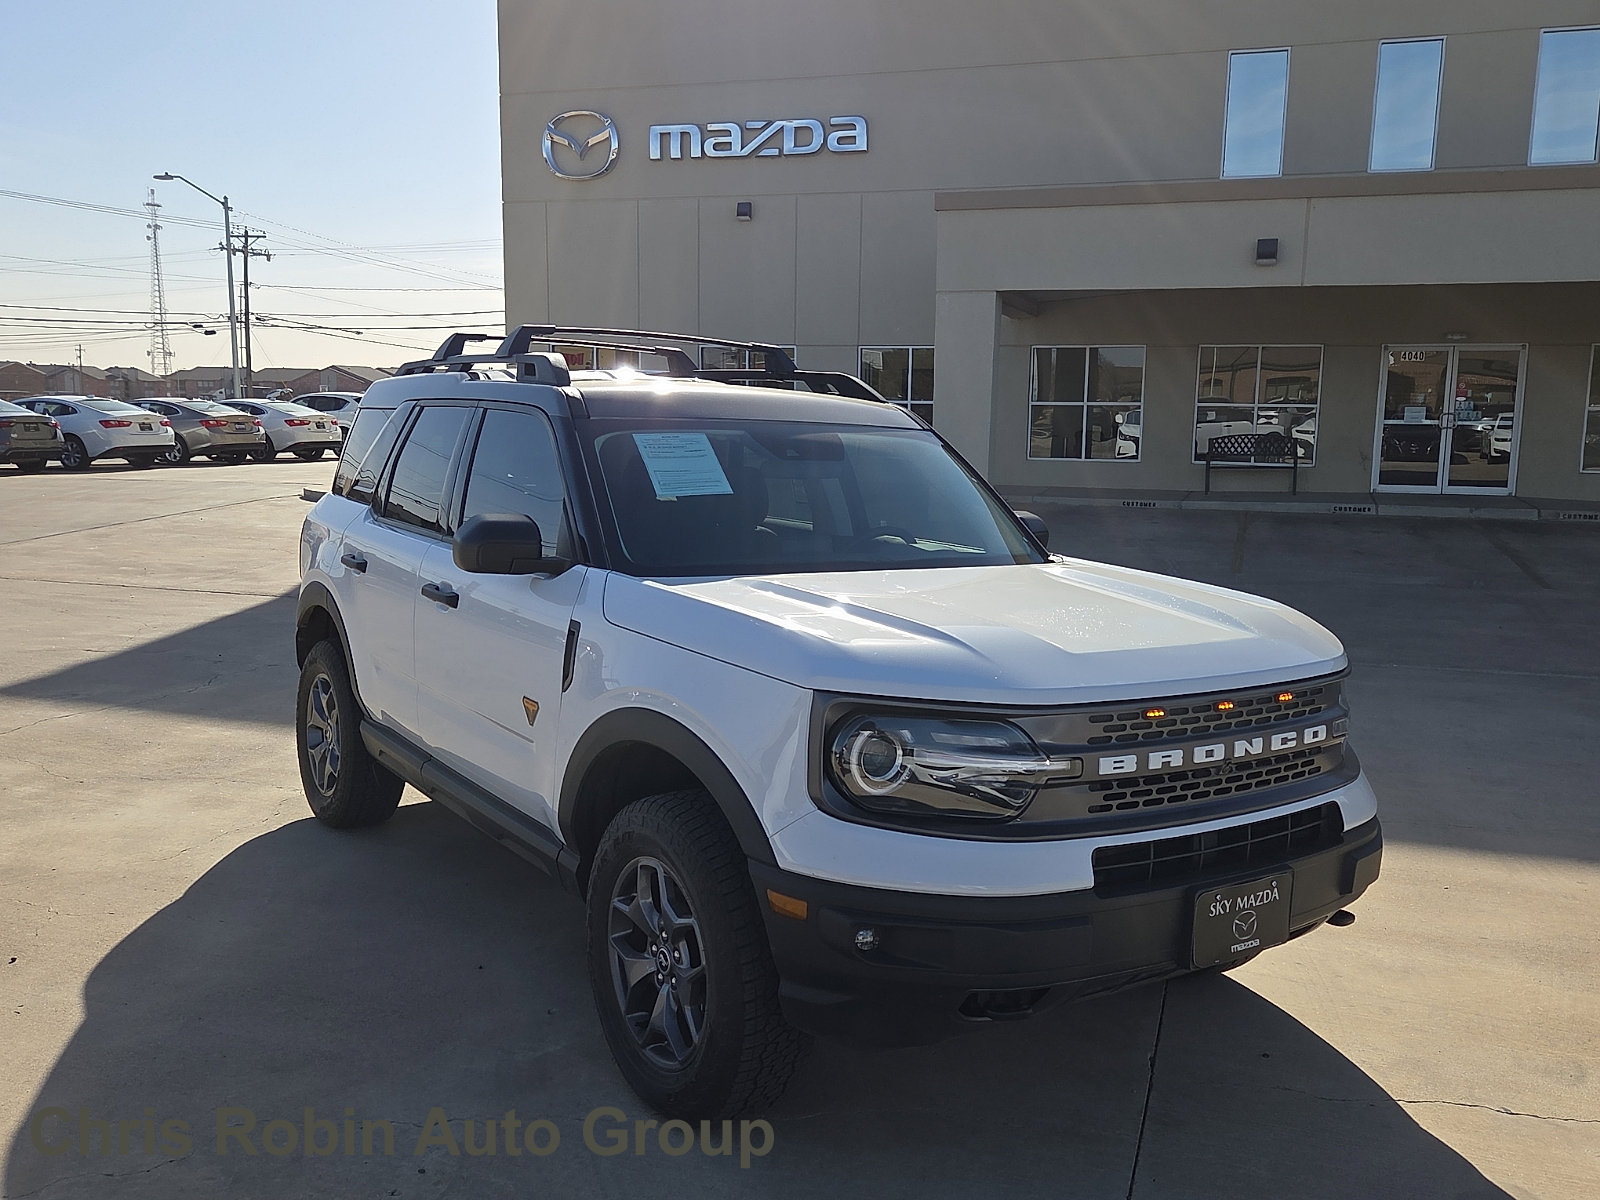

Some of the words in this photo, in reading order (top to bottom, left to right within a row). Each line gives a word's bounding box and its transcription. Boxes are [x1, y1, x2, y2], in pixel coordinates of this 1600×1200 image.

[1401, 351, 1425, 361] 4040
[1562, 513, 1600, 521] CUSTOME
[1098, 724, 1327, 776] BRONCO
[1208, 899, 1233, 917] SKY
[1235, 887, 1280, 911] MAZDA
